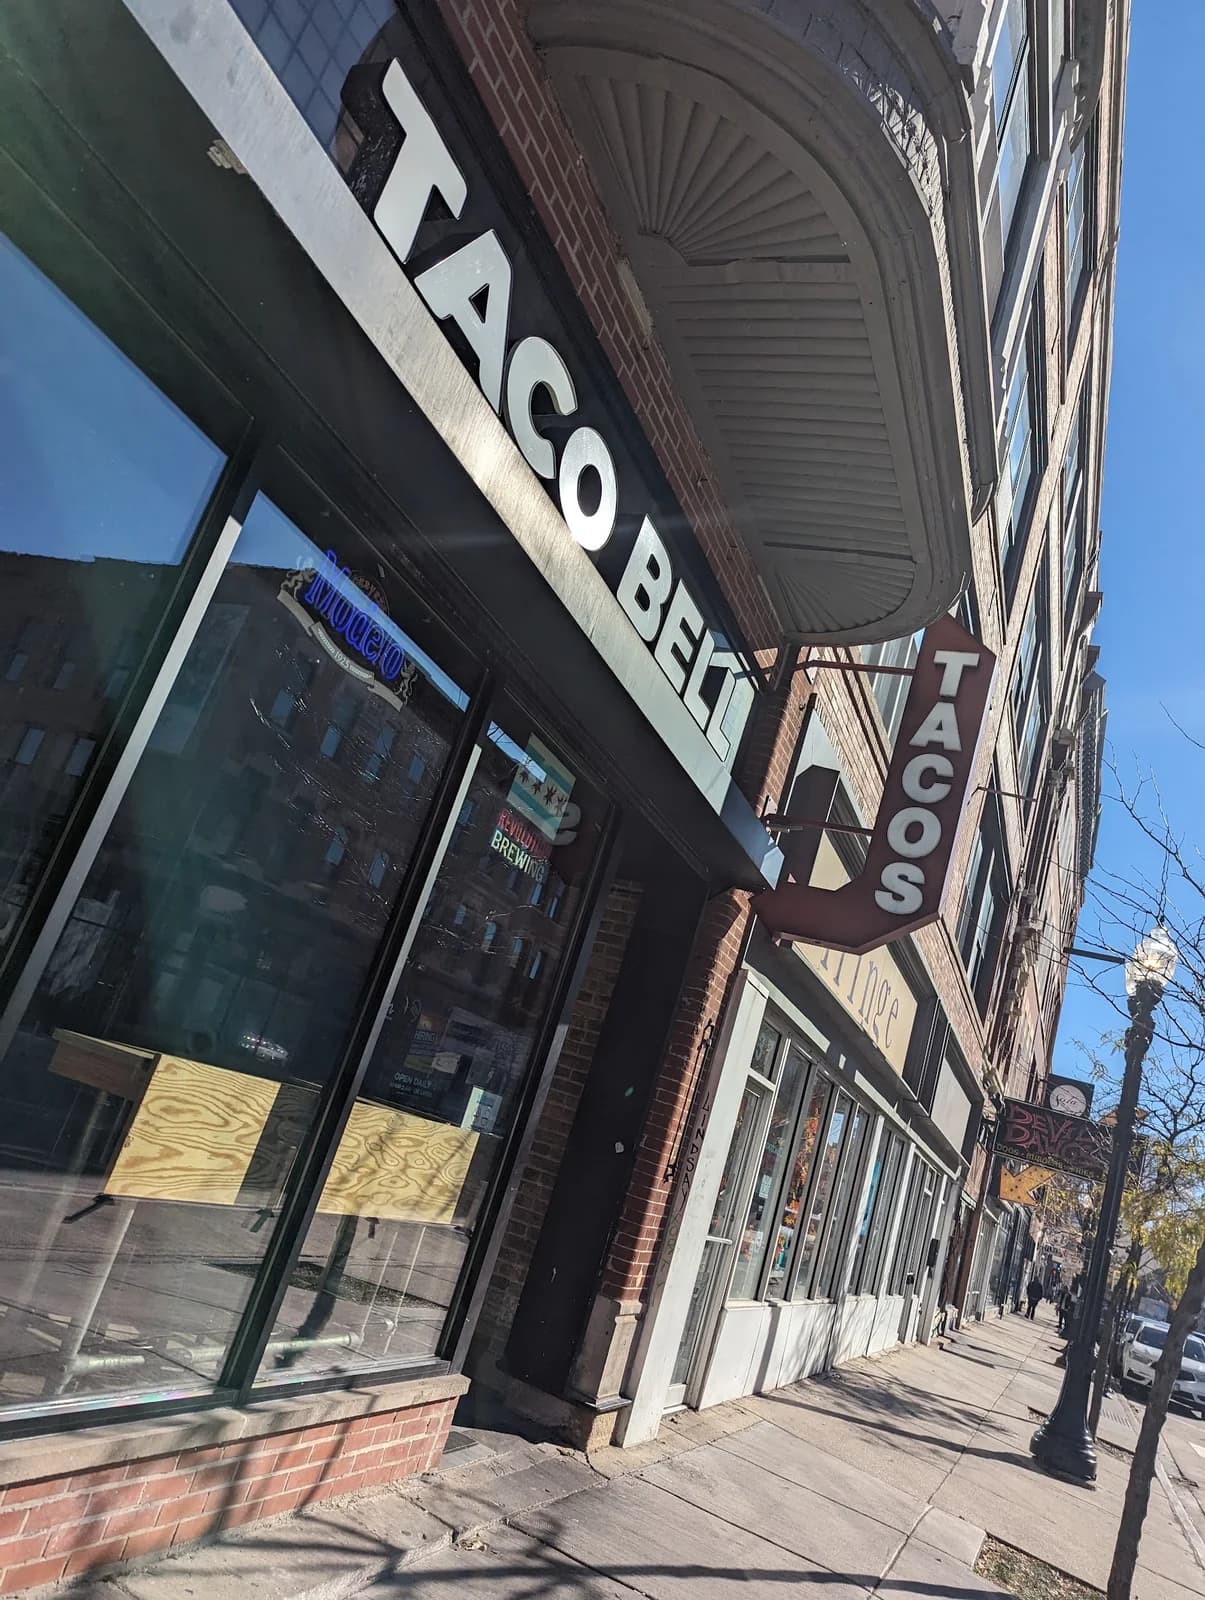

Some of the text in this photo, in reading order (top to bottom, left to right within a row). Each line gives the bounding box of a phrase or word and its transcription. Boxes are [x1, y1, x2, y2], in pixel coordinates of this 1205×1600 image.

[373, 57, 738, 763] TACO BELL
[304, 549, 406, 680] Modelo
[498, 809, 553, 861] REVOLU
[874, 650, 980, 915] TACOS
[490, 827, 547, 884] BREWING
[393, 1071, 413, 1083] OPEN
[680, 1092, 711, 1211] LINDSAY
